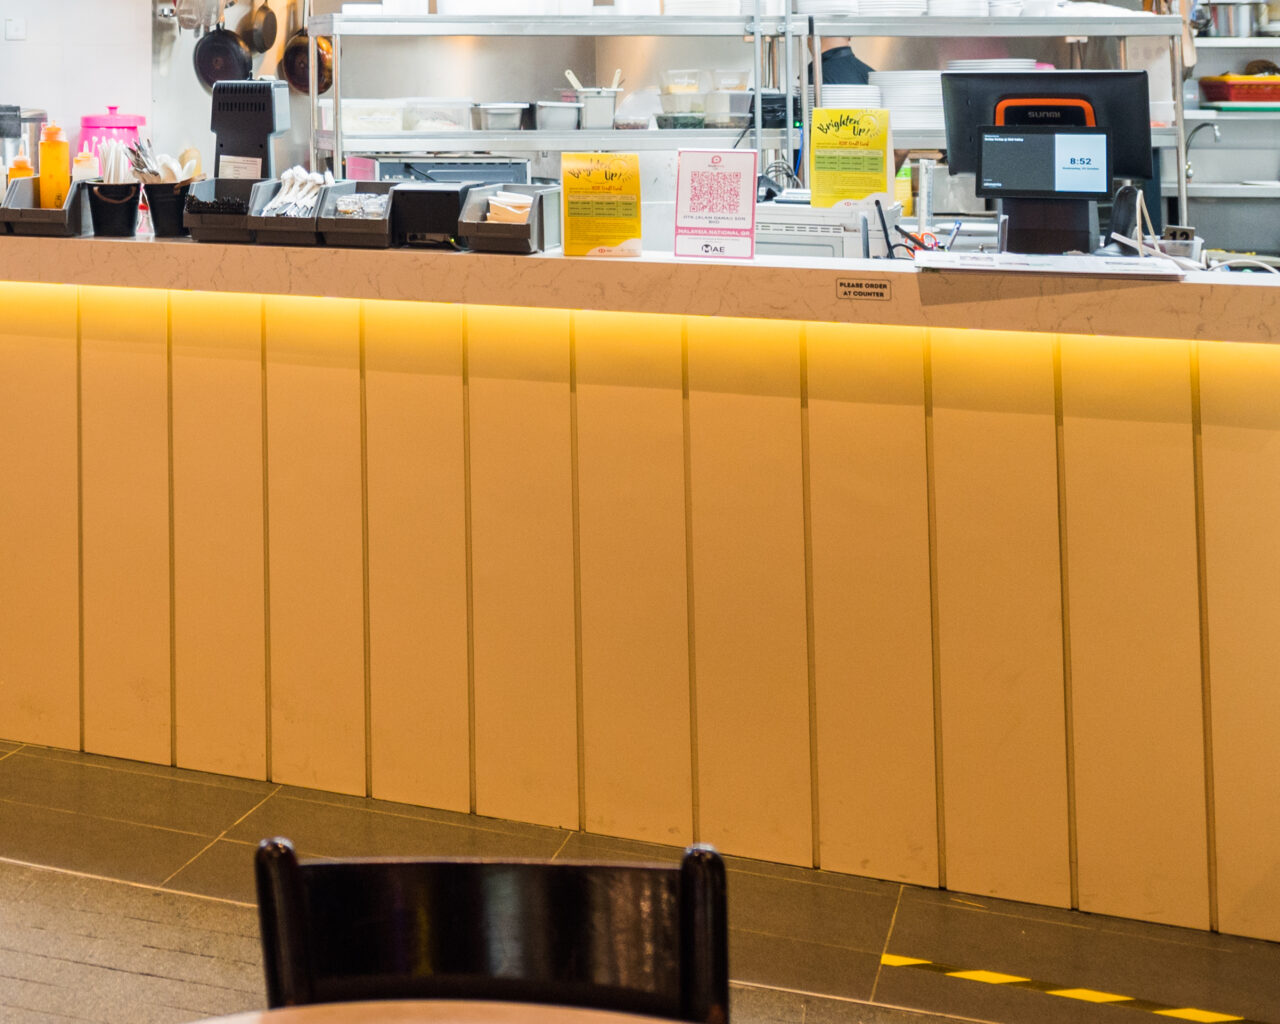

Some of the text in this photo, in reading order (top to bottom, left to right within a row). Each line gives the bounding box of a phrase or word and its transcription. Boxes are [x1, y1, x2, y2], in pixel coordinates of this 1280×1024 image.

[816, 114, 860, 135] Brighten
[1069, 157, 1092, 166] 8:52
[864, 282, 888, 290] ORDER
